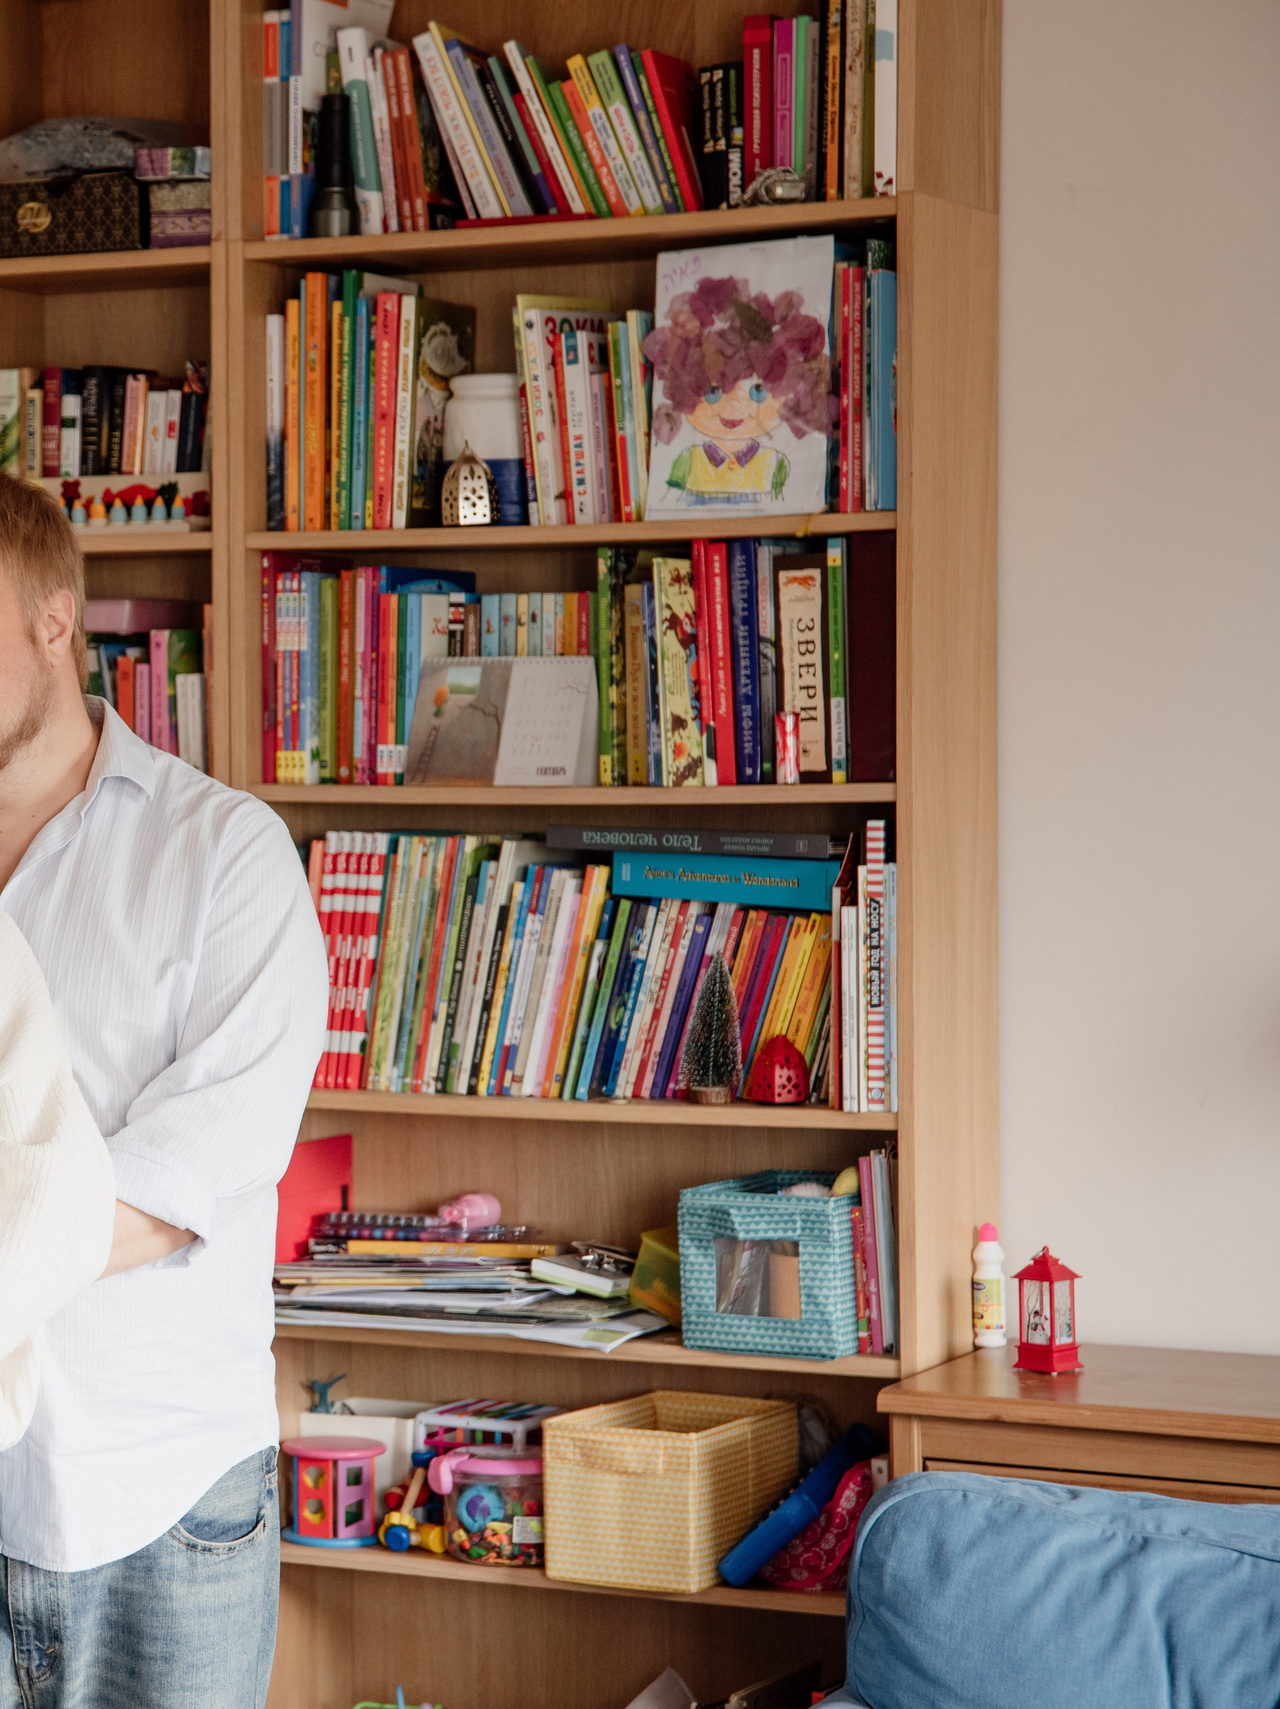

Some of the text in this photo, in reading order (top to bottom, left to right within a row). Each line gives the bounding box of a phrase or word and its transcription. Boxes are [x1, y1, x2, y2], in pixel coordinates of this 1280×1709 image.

[532, 384, 543, 416] ЗОКИ
[573, 433, 586, 485] МАРШАК
[758, 575, 768, 634] НАСКВОЗЬ
[735, 553, 753, 754] МИФЫ ДРЕВНЕЙ ГРЕЦИИ
[796, 616, 818, 723] ЗВЕРИ
[582, 831, 702, 852] Тело человека
[676, 866, 731, 884] Adventures
[741, 872, 799, 888] Wonderland
[869, 900, 880, 1005] НОВЫЙ ГОД НА НОСУ
